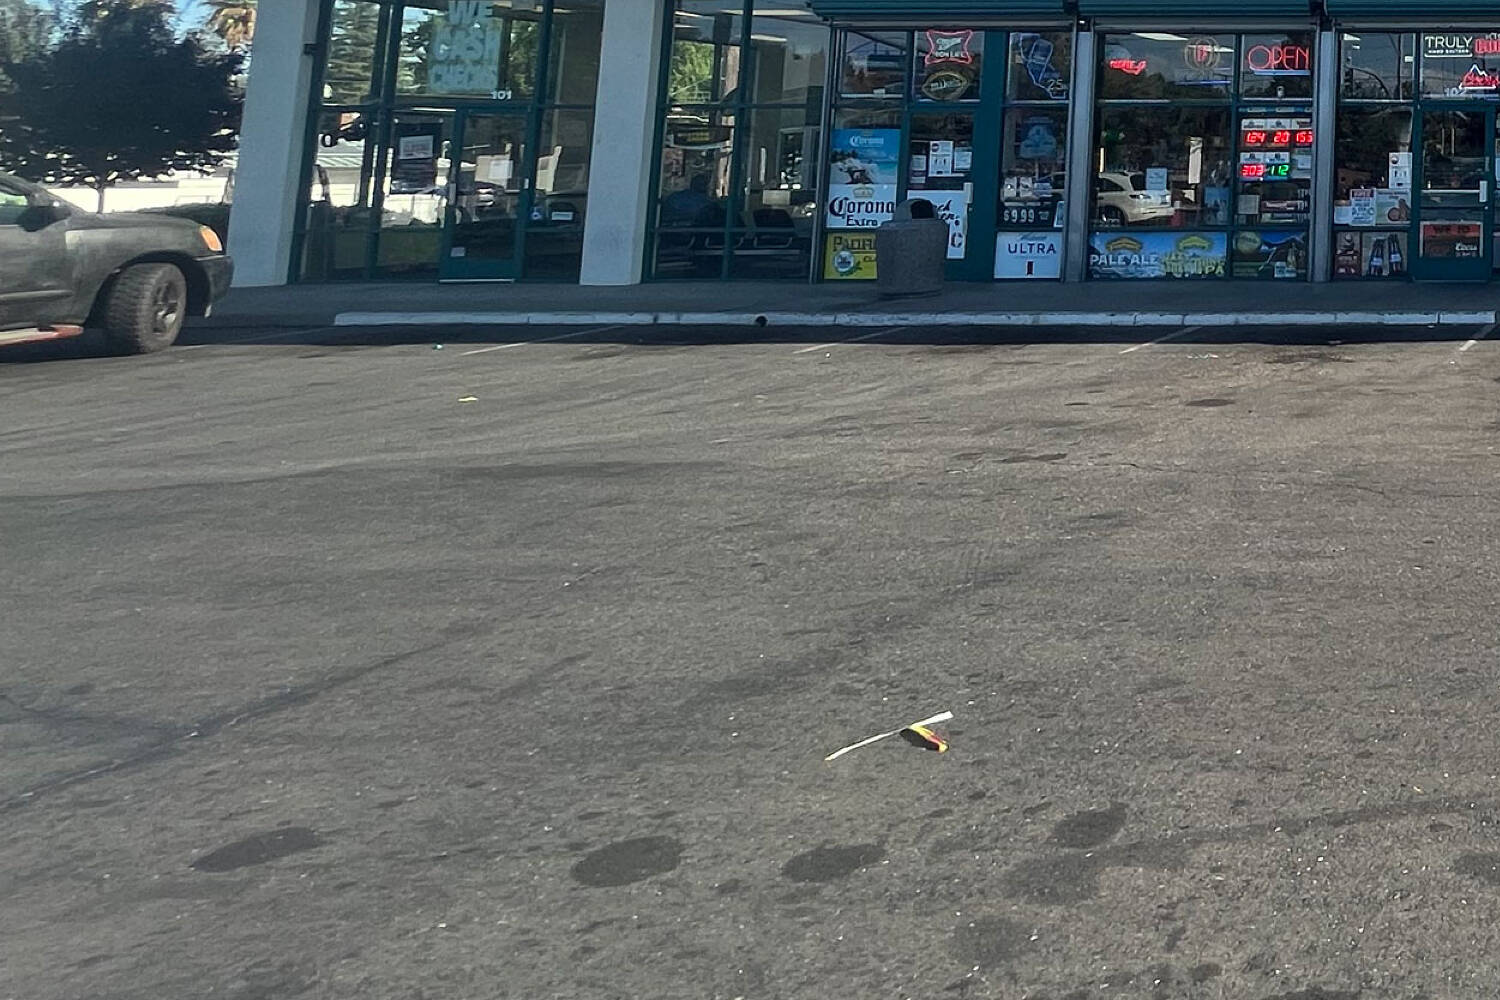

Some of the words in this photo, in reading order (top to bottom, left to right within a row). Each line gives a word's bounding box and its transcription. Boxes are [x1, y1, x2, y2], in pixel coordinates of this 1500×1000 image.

[1424, 36, 1473, 48] TRULY
[1248, 45, 1309, 72] OPEN
[490, 90, 512, 100] 101
[829, 197, 895, 220] Corona
[846, 214, 878, 227] Extra
[1007, 243, 1057, 254] ULTRA
[1089, 254, 1126, 265] PALE
[1129, 254, 1159, 265] ALE
